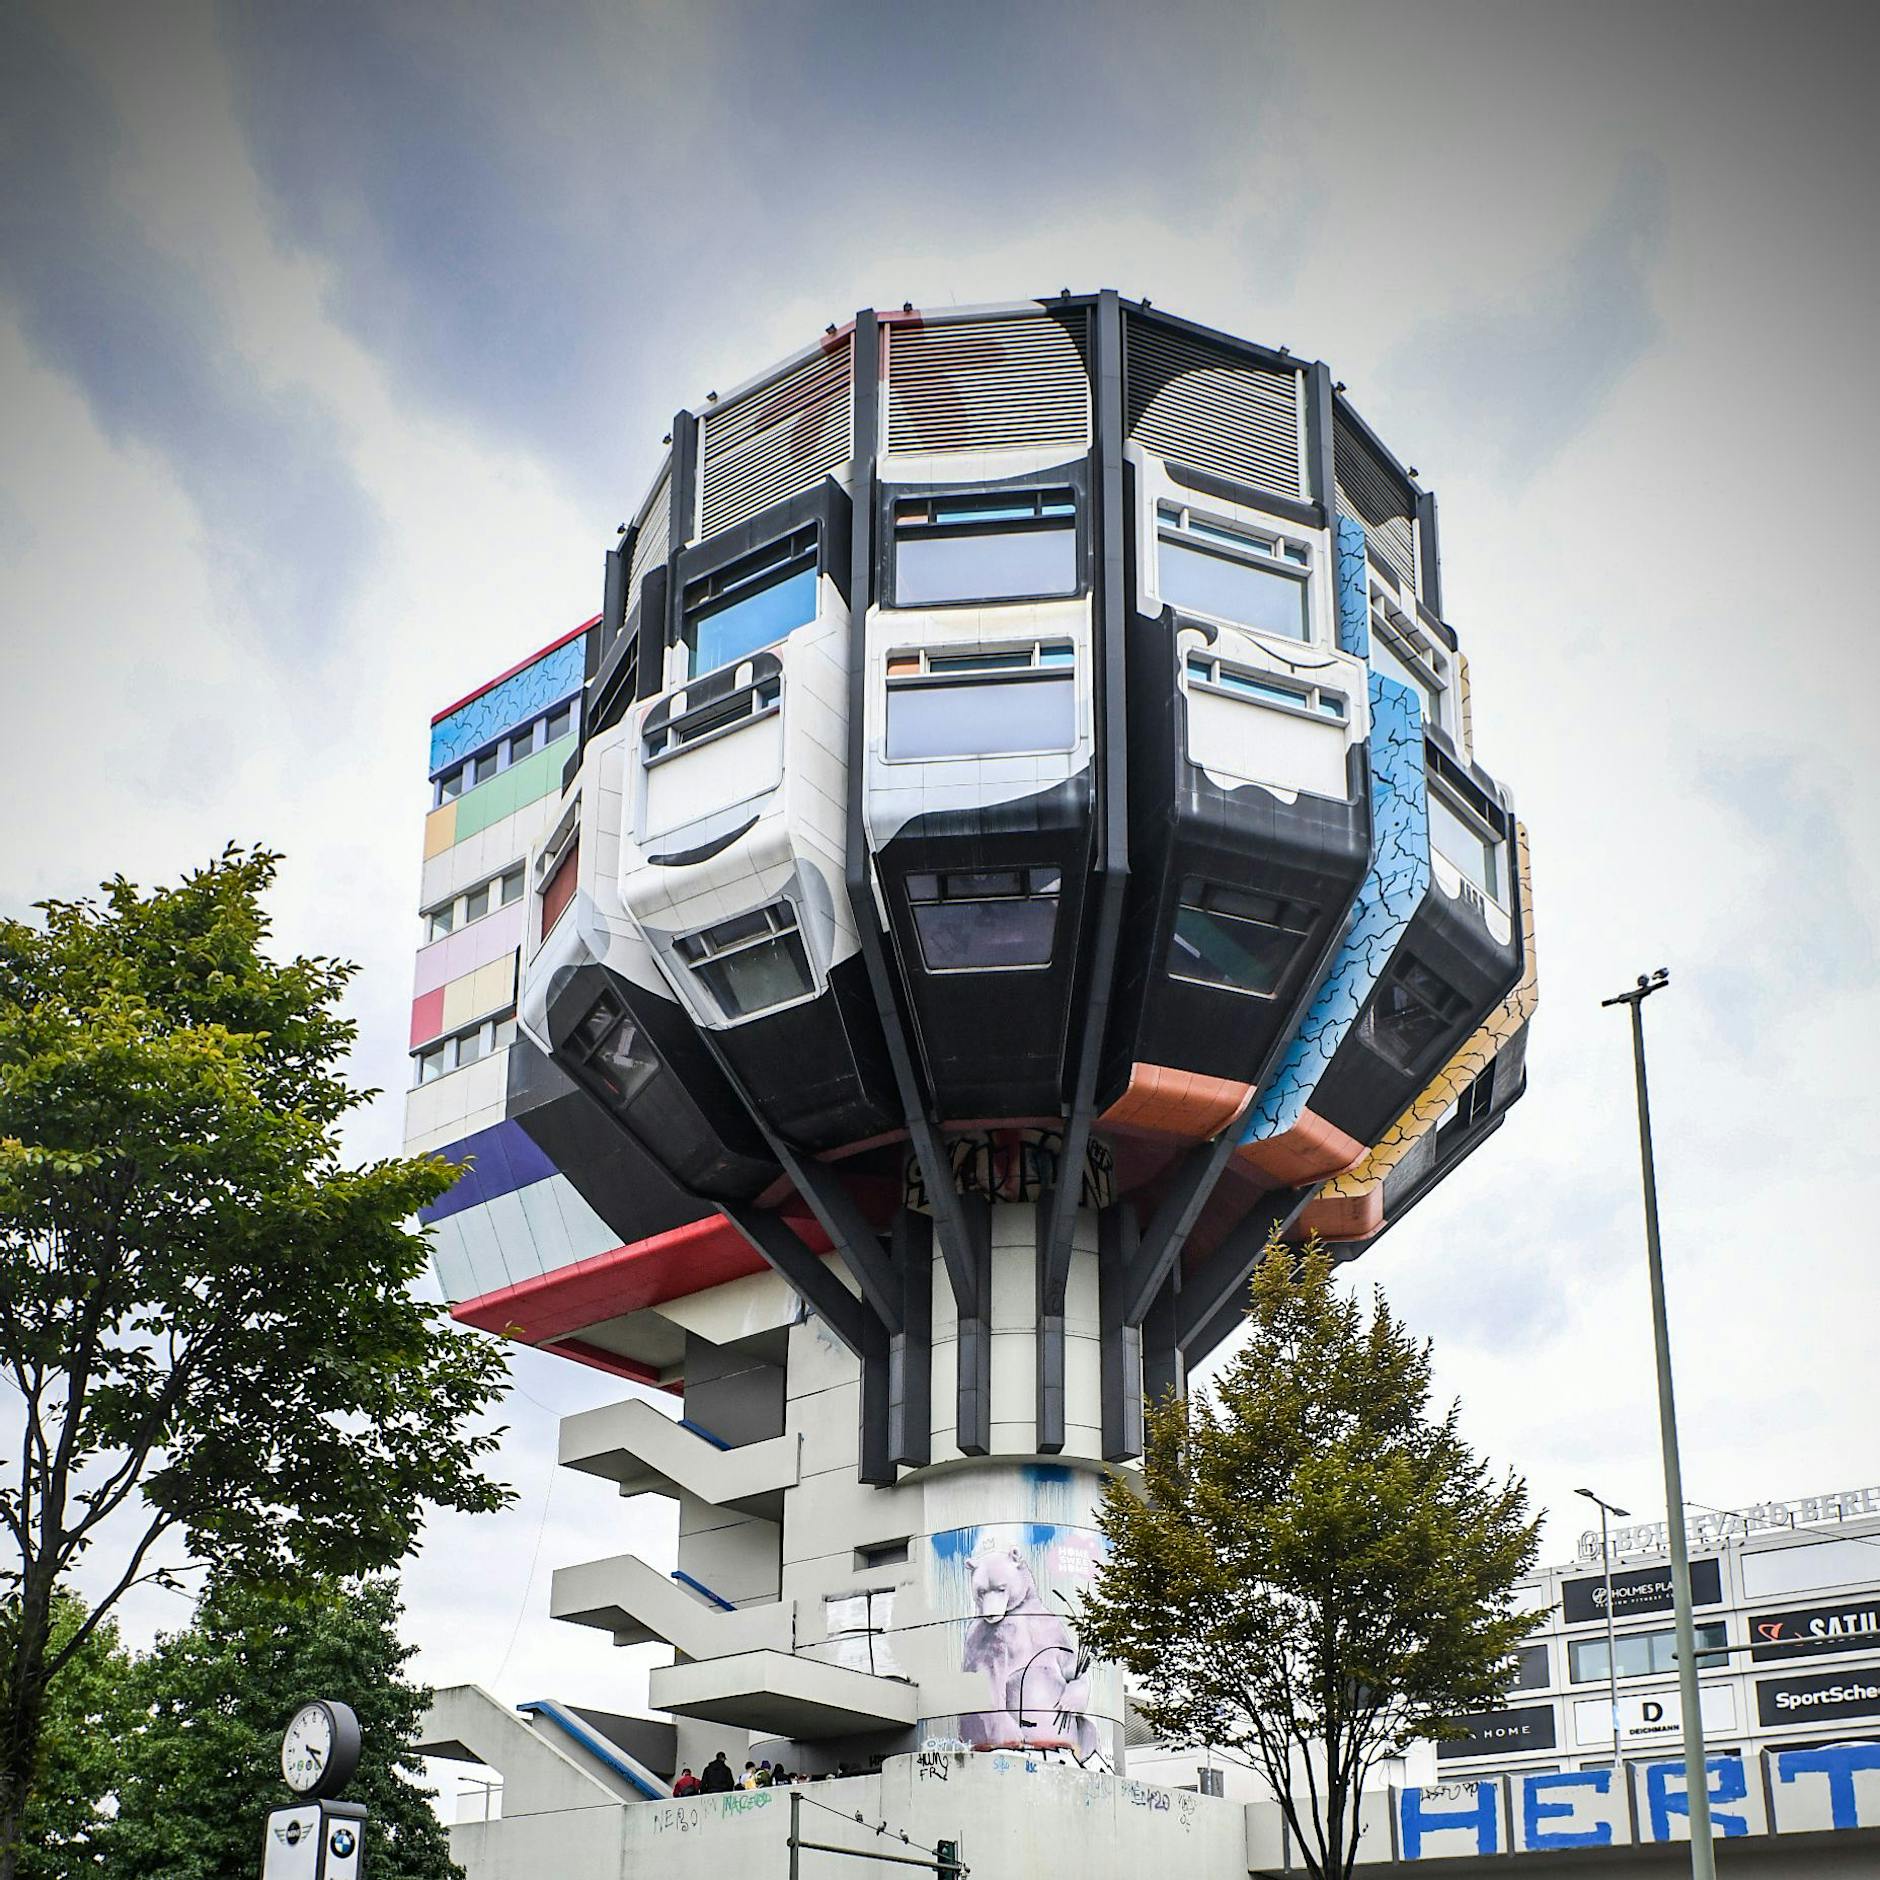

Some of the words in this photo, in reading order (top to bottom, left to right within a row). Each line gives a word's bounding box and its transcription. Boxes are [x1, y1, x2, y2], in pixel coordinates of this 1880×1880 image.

[1612, 1584, 1654, 1598] HOLMES
[1775, 1684, 1880, 1710] SportSche
[1484, 1726, 1531, 1738] HOME
[1629, 1724, 1680, 1735] DEICHMANN
